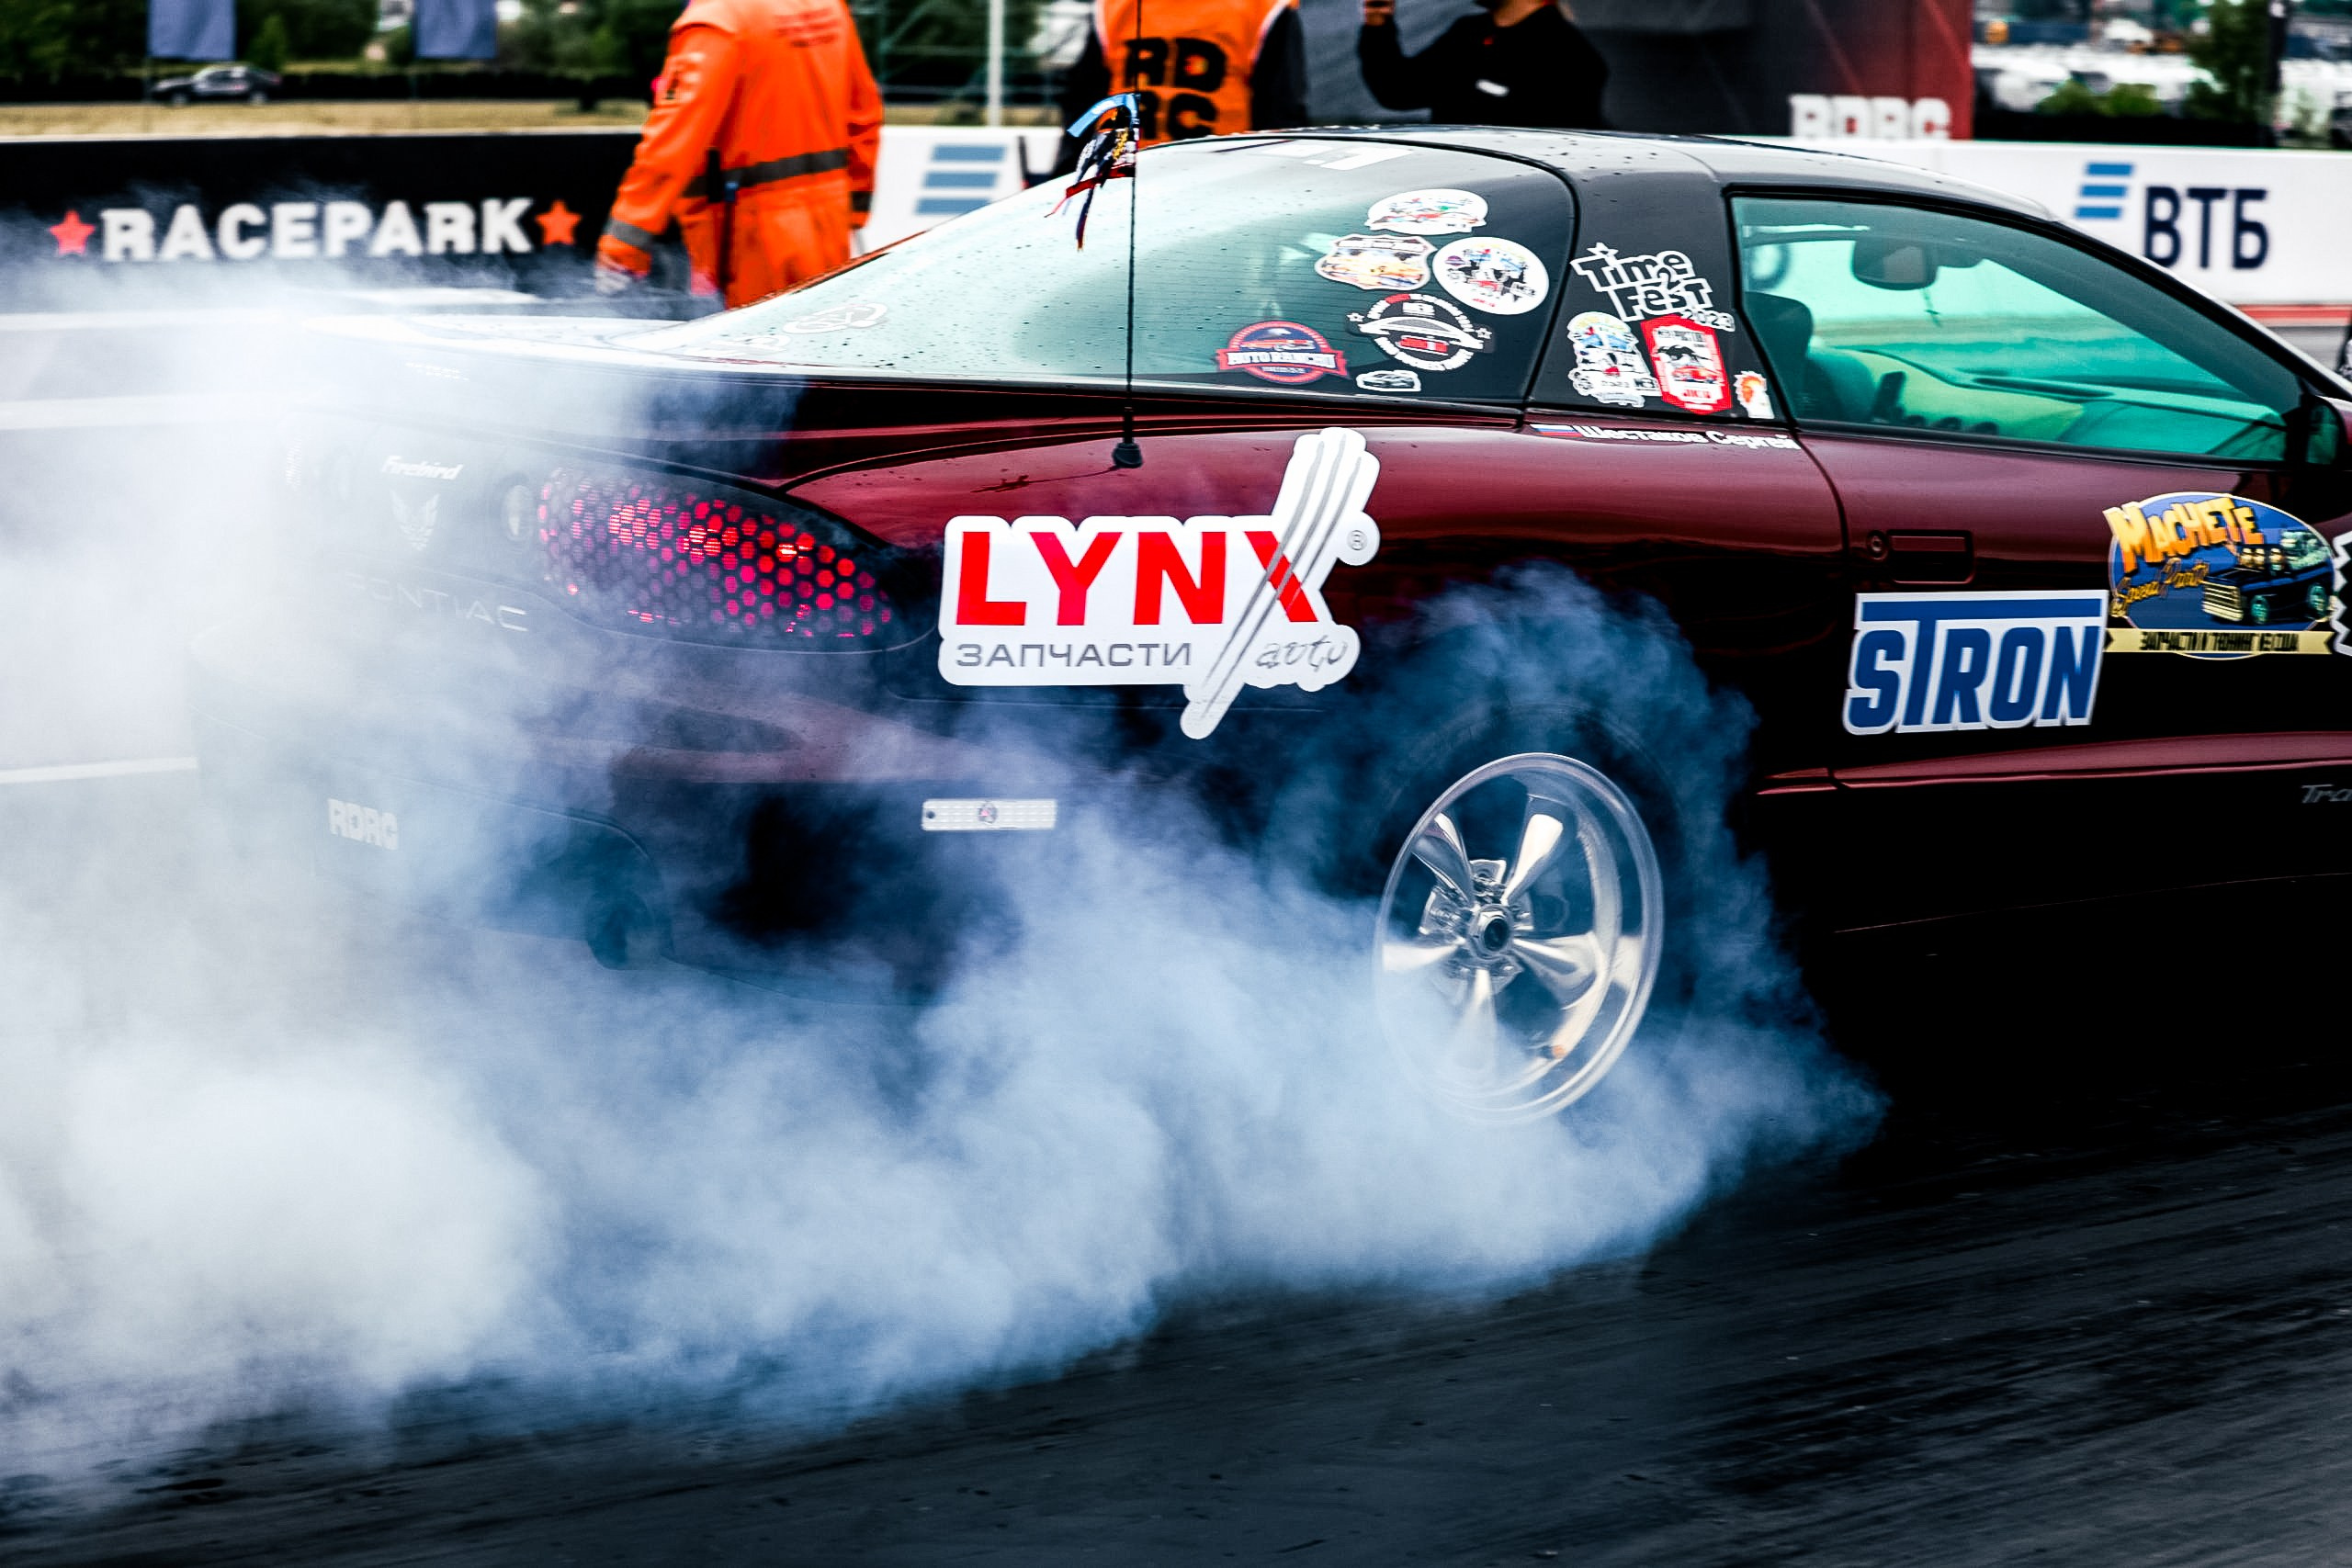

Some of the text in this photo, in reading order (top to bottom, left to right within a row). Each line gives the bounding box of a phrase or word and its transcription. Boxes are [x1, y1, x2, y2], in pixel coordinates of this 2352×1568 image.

[1125, 37, 1227, 92] RD
[1789, 94, 1951, 139] RDRC
[101, 198, 536, 263] RACEPARK
[2143, 186, 2269, 270] ВТБ
[1573, 425, 1803, 450] Шестаков Сергей
[380, 455, 464, 480] Firebird
[2105, 497, 2265, 574] MACHETE
[956, 530, 1320, 626] LYNX
[956, 643, 1192, 668] ЗАПЧАСТИ
[1848, 598, 2102, 728] STRON
[327, 797, 398, 851] RDRC
